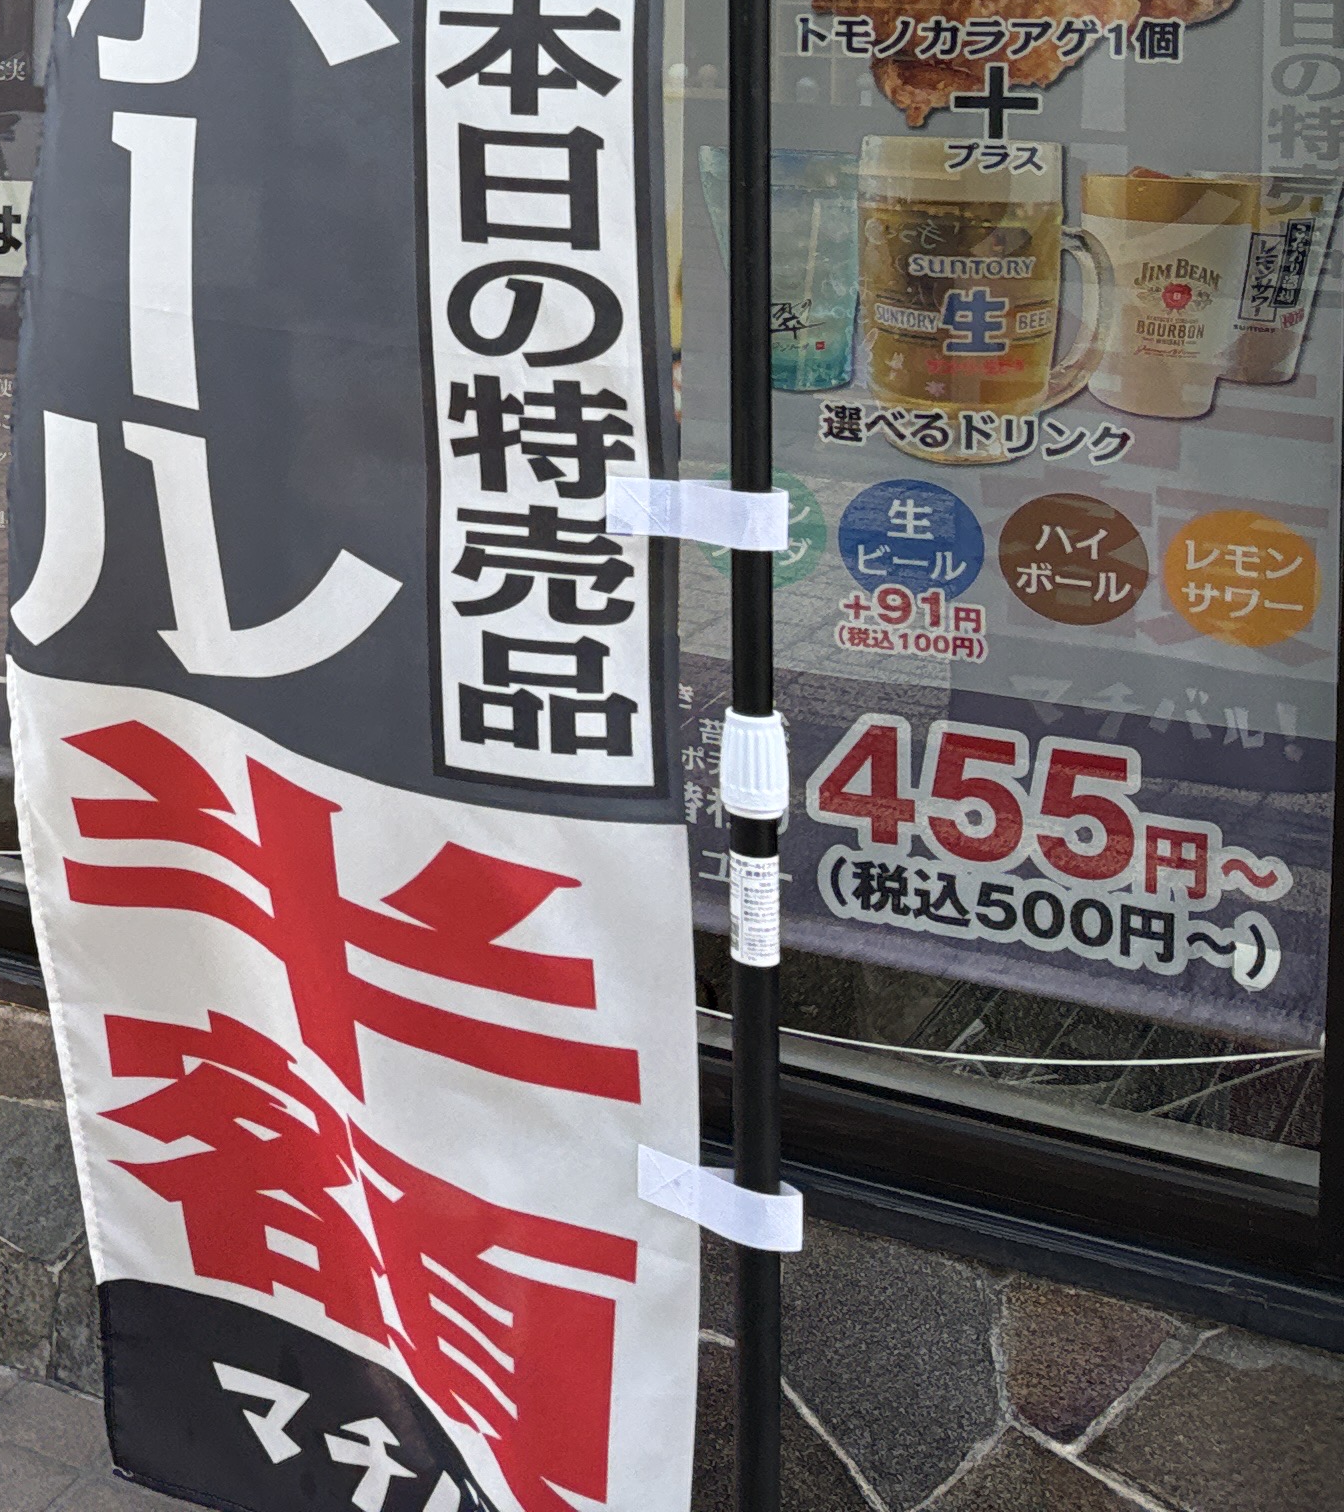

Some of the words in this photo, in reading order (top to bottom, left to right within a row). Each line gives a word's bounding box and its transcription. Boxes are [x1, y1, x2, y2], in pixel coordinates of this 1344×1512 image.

[796, 14, 1184, 61] トモノカラアゲ1個
[946, 141, 1045, 174] プラス
[908, 254, 1036, 280] SUNTORY
[1134, 262, 1173, 287] JIM
[1175, 257, 1223, 291] BEAM
[941, 287, 1010, 357] 生
[1136, 320, 1205, 339] BOURBON
[818, 402, 1136, 465] 選べるドリンク
[887, 498, 933, 542] 生
[857, 541, 966, 583] ビール
[1035, 524, 1110, 562] ハイ
[1183, 538, 1302, 581] レモン
[1016, 560, 1131, 606] ボール
[1181, 580, 1304, 618] サワー
[844, 587, 983, 633] +91円
[837, 626, 988, 660] (税込100円)
[61, 720, 643, 1512] 半額
